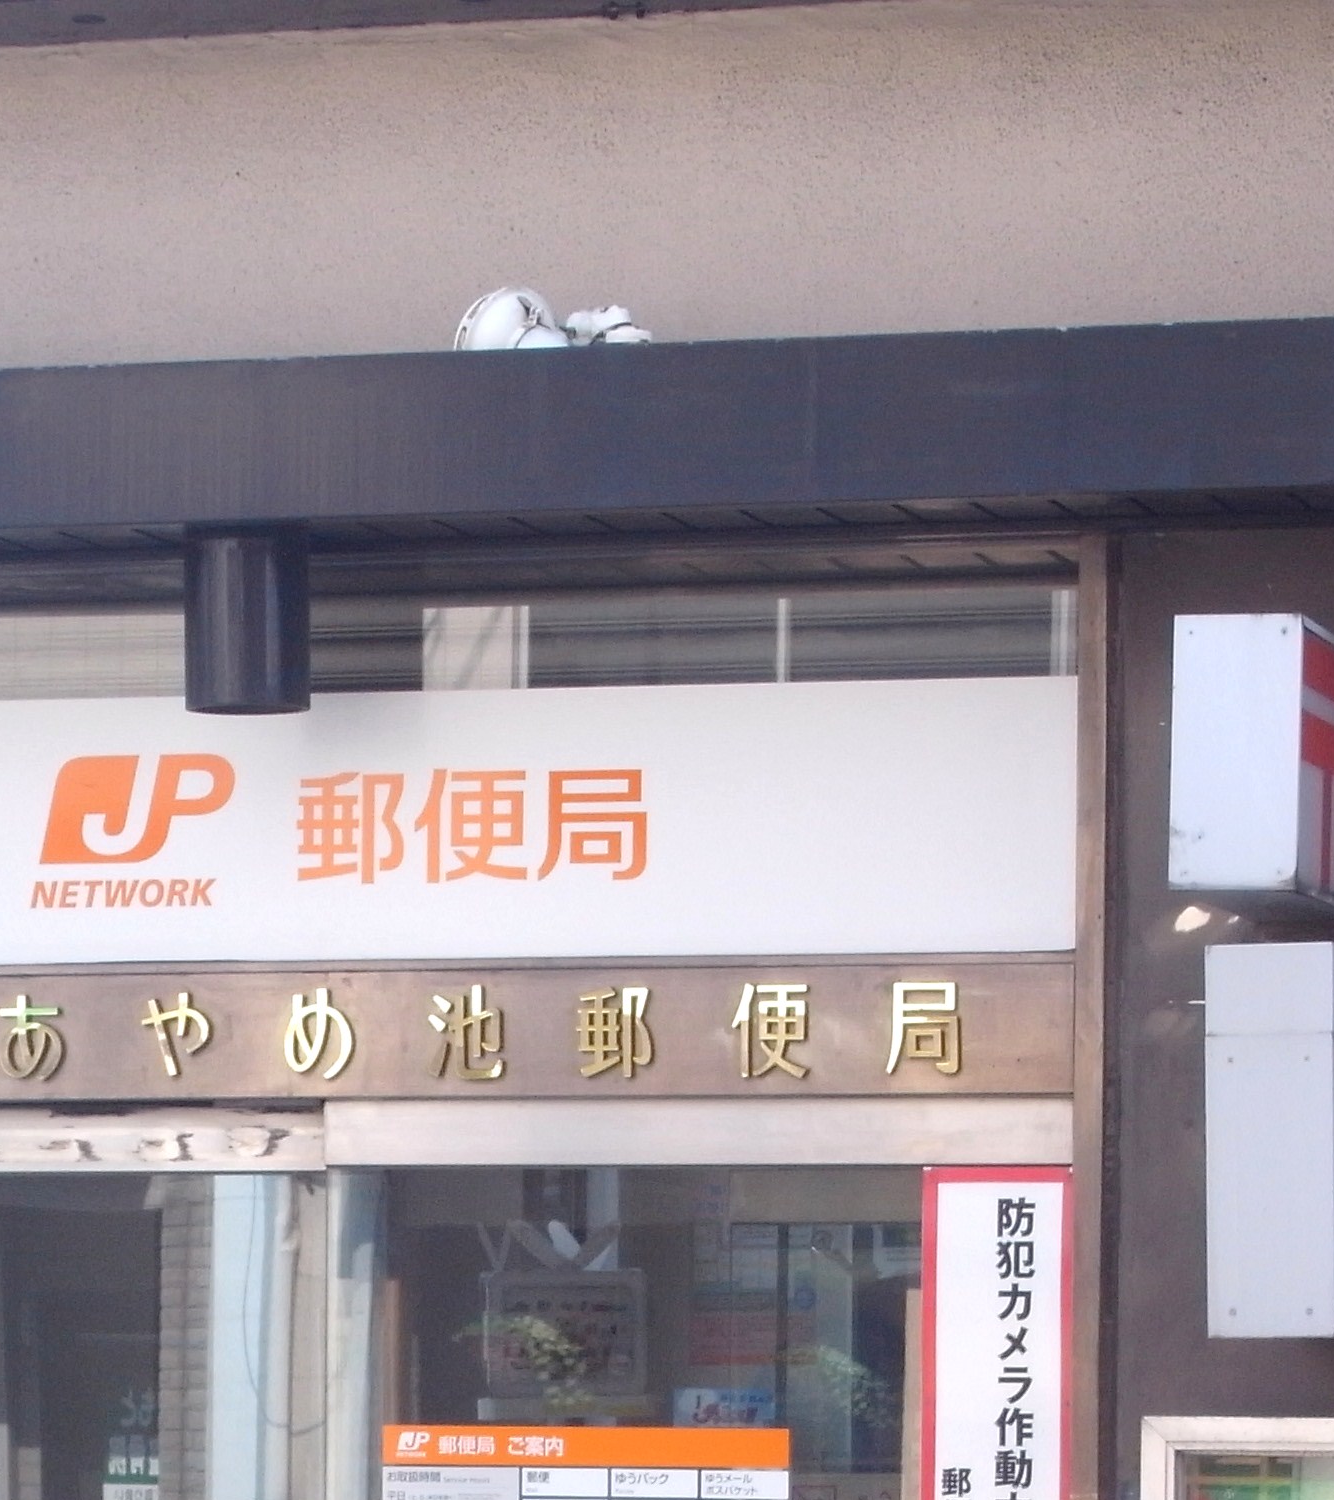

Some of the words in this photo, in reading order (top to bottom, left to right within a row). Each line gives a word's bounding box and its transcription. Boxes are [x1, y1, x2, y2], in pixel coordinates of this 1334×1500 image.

[295, 767, 650, 884] 郵便局
[28, 879, 217, 910] NETWORK
[438, 1436, 495, 1456] 郵便局
[508, 1436, 564, 1457] ご案内
[526, 1471, 550, 1483] 郵便
[705, 1475, 753, 1484] ゆうメール
